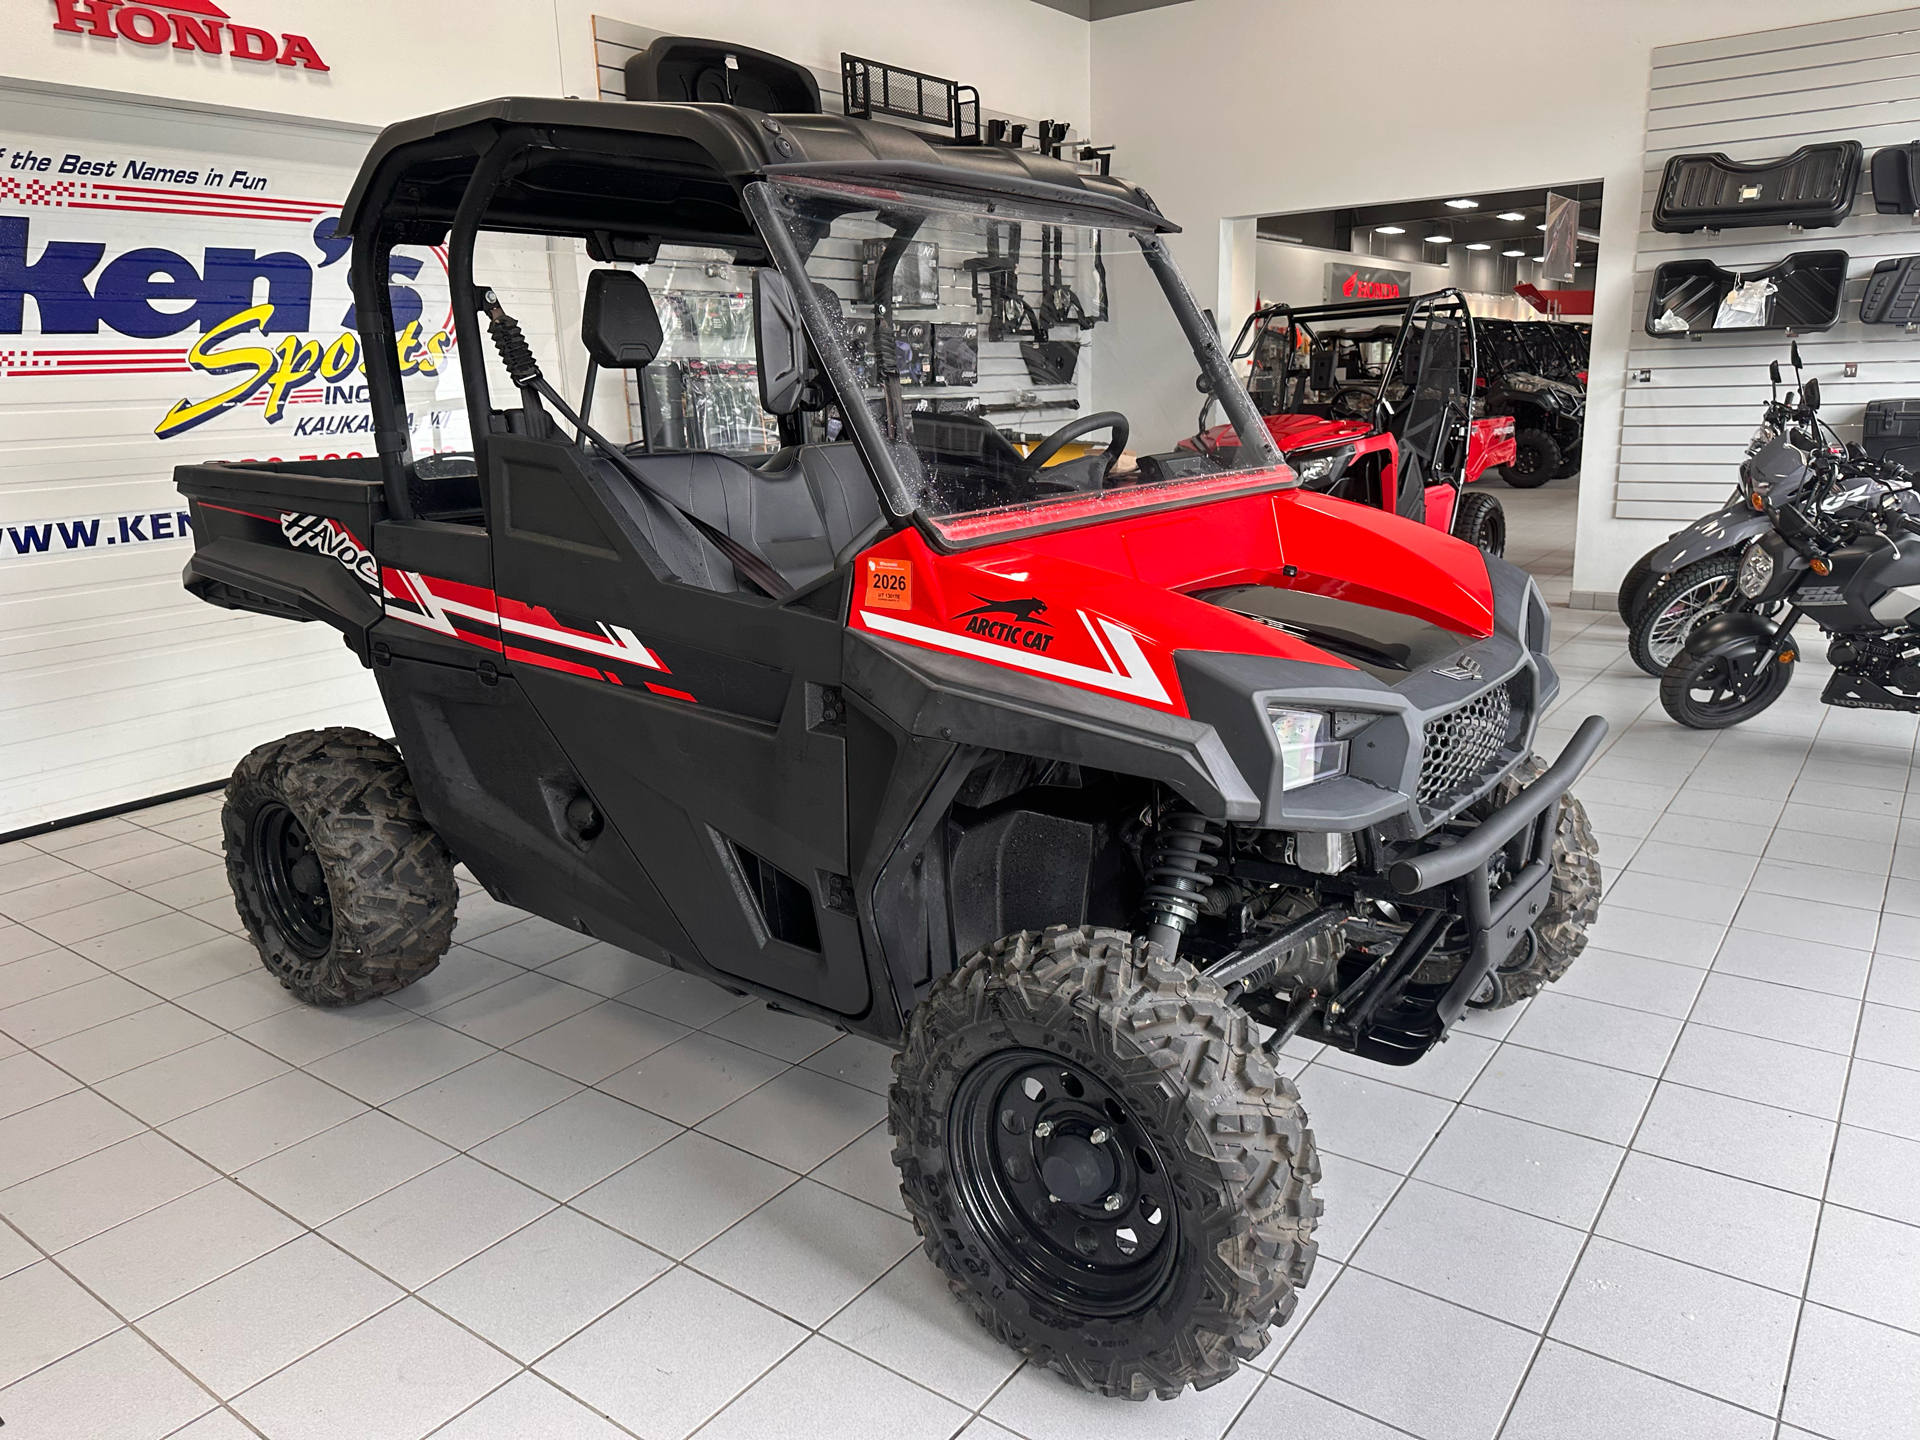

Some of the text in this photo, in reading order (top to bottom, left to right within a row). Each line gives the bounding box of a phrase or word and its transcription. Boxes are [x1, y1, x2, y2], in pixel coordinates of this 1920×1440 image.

[53, 0, 330, 71] HONDA
[9, 150, 51, 173] the
[58, 154, 117, 178] Best
[122, 160, 199, 185] Names
[204, 168, 223, 186] in
[228, 170, 268, 191] Fun
[1357, 281, 1400, 299] HONDA
[155, 304, 451, 439] Spots
[281, 512, 382, 589] HAVOC
[872, 573, 906, 591] 2026
[965, 615, 1055, 653] ARCTIC CAT
[1833, 698, 1896, 710] HONDA
[1042, 1032, 1127, 1093] POWER
[922, 1173, 981, 1275] DURO
